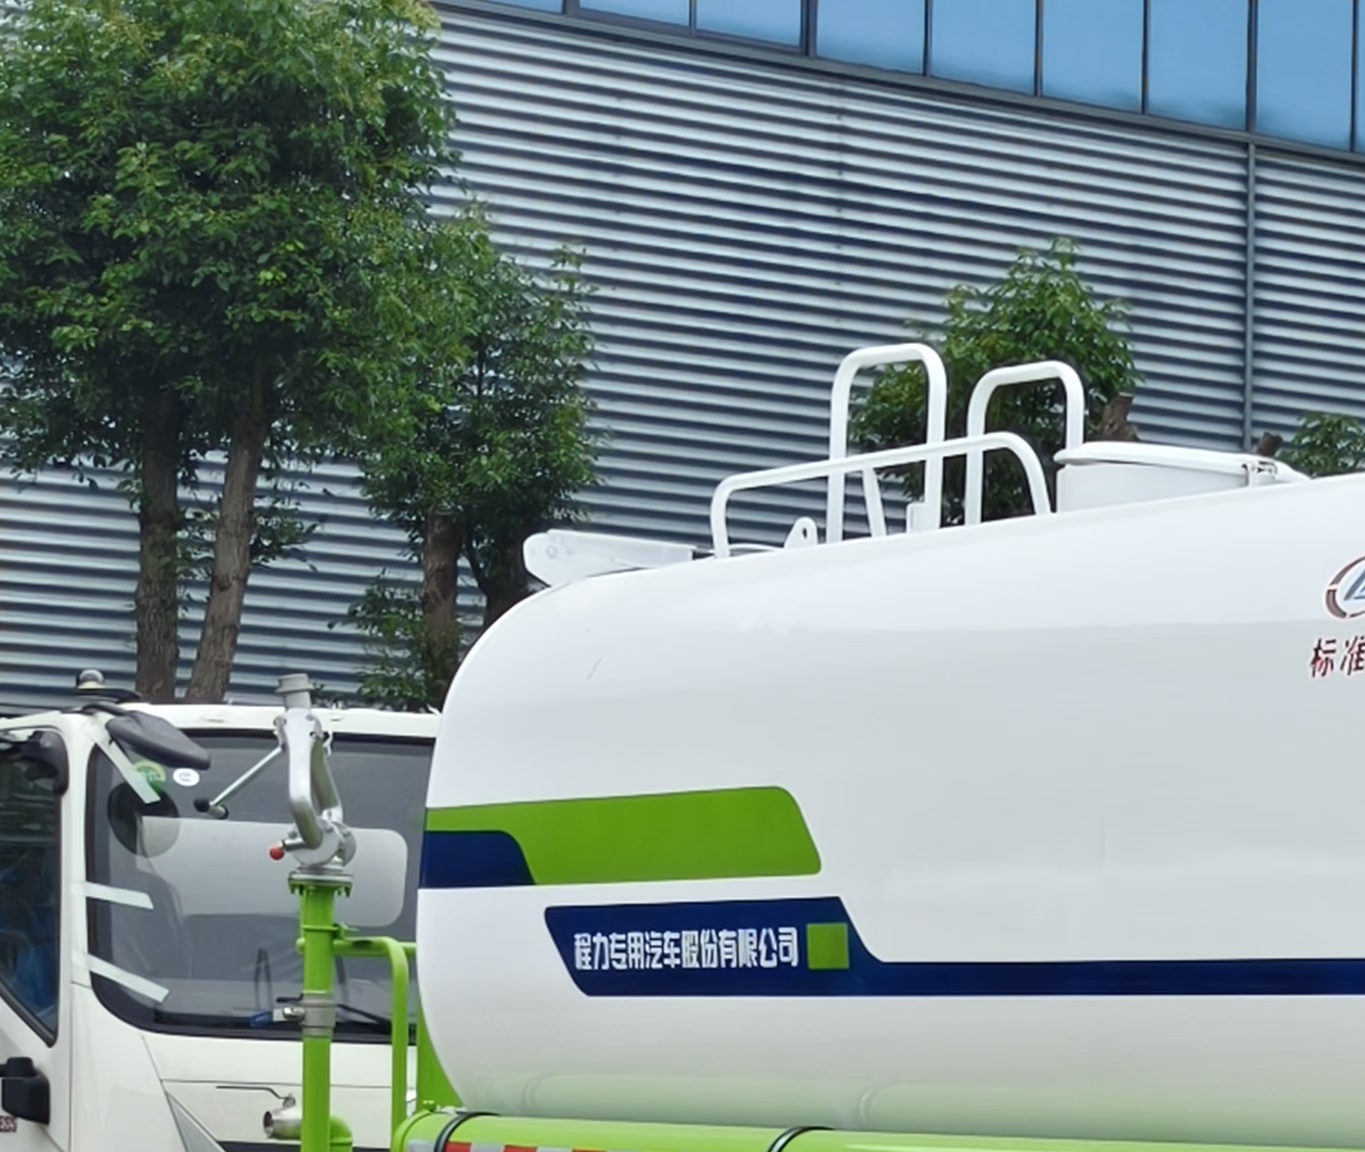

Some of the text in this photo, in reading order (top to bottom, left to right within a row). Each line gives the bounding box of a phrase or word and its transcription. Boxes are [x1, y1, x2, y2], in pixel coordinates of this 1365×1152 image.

[574, 927, 799, 971] 程力专用汽车股份有限公司
